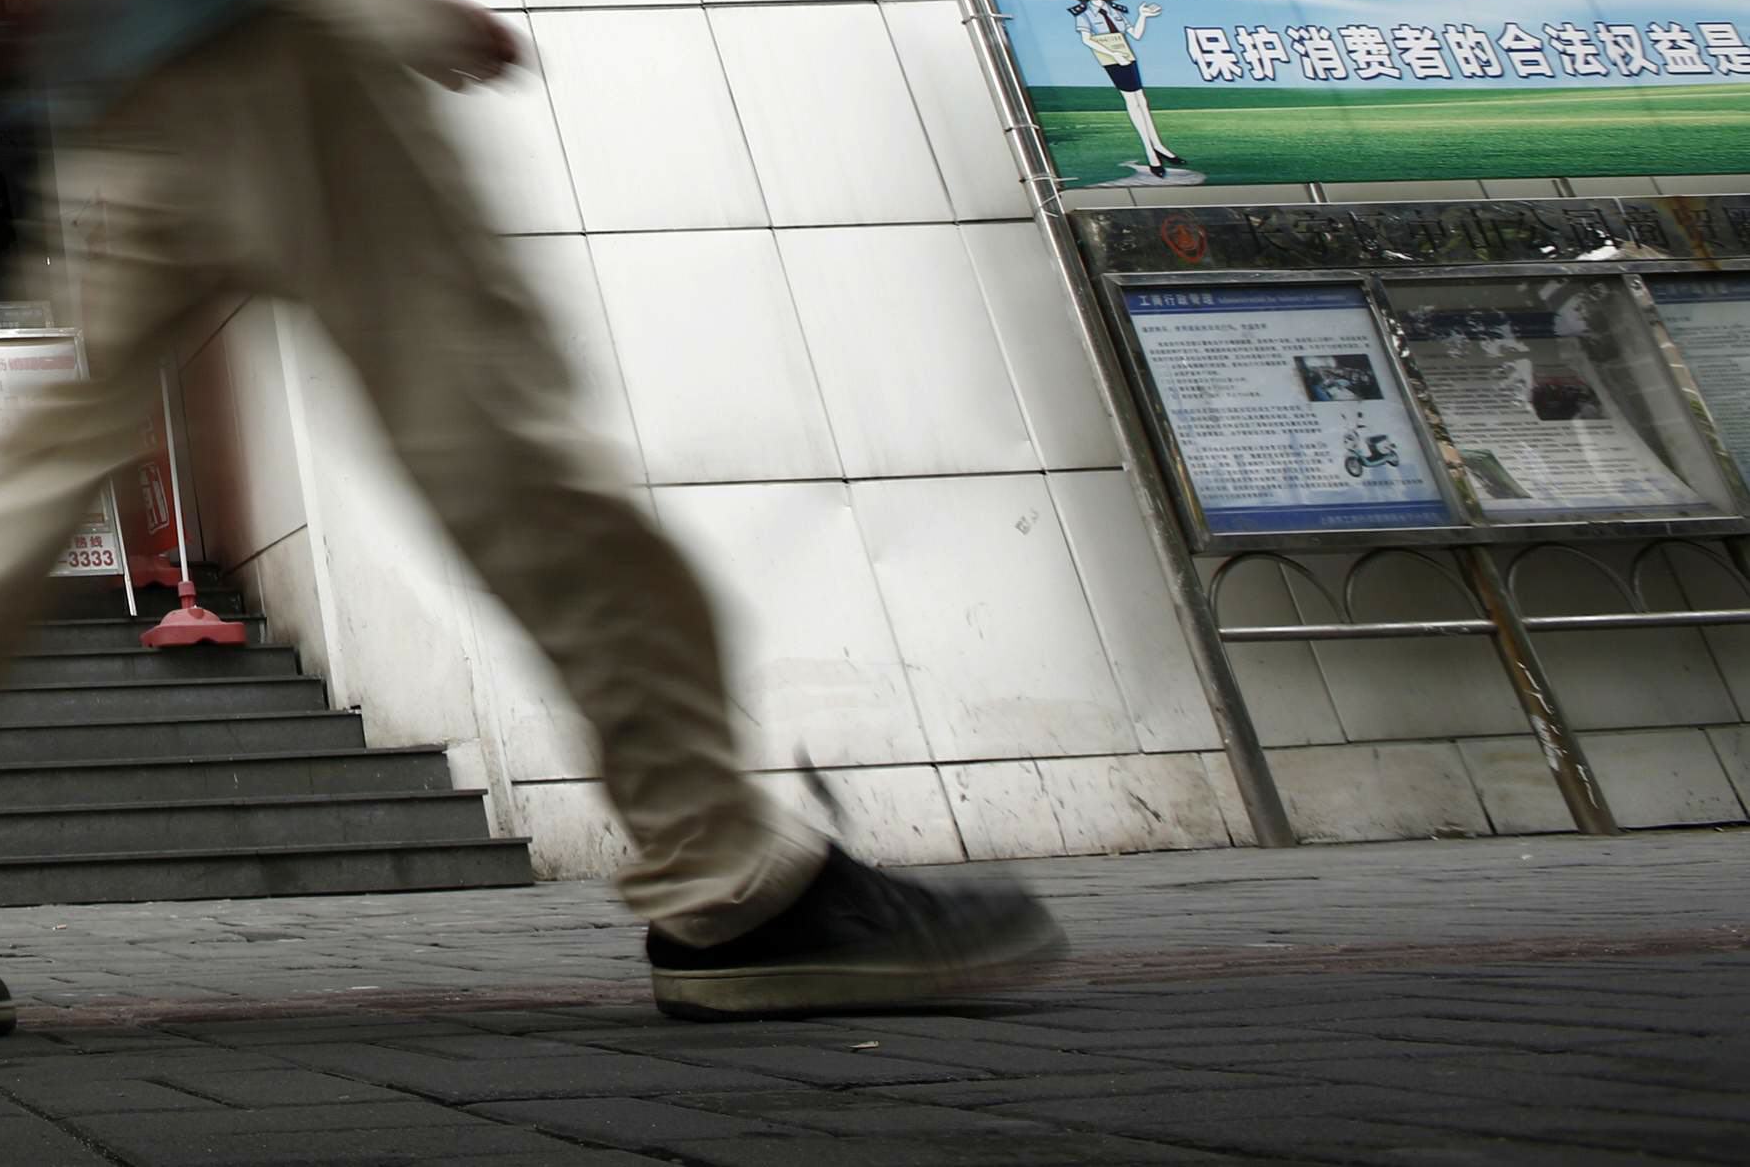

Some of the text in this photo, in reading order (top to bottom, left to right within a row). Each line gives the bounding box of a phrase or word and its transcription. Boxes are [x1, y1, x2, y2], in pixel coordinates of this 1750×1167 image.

[1184, 20, 1750, 82] 保护消费者的合法权益是
